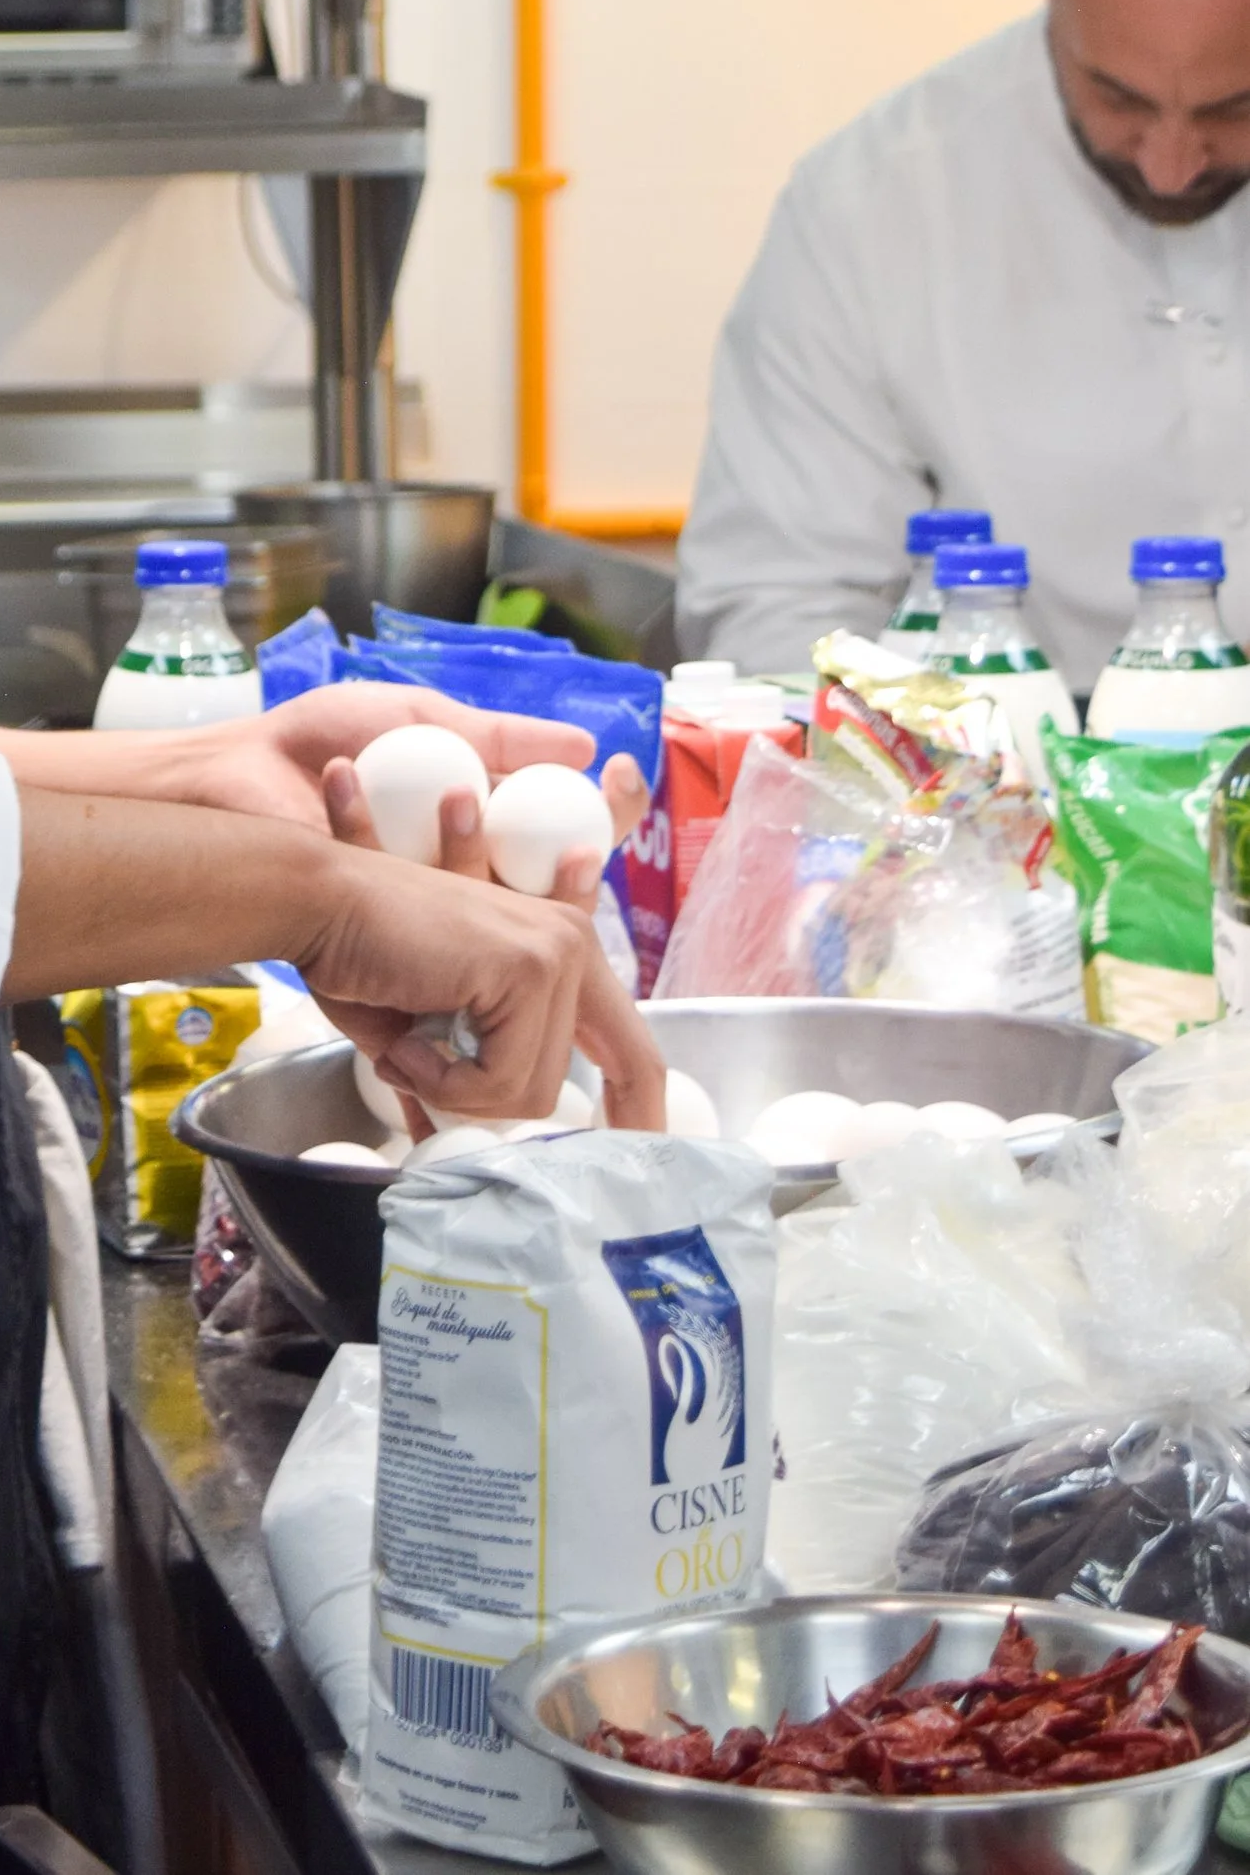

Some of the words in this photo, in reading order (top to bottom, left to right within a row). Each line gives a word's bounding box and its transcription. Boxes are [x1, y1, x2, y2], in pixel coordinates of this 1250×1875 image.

[421, 1284, 467, 1301] RECETA
[442, 1302, 460, 1322] de
[426, 1318, 515, 1345] mantequilla
[651, 1474, 746, 1534] CISNE
[655, 1533, 743, 1598] ORO
